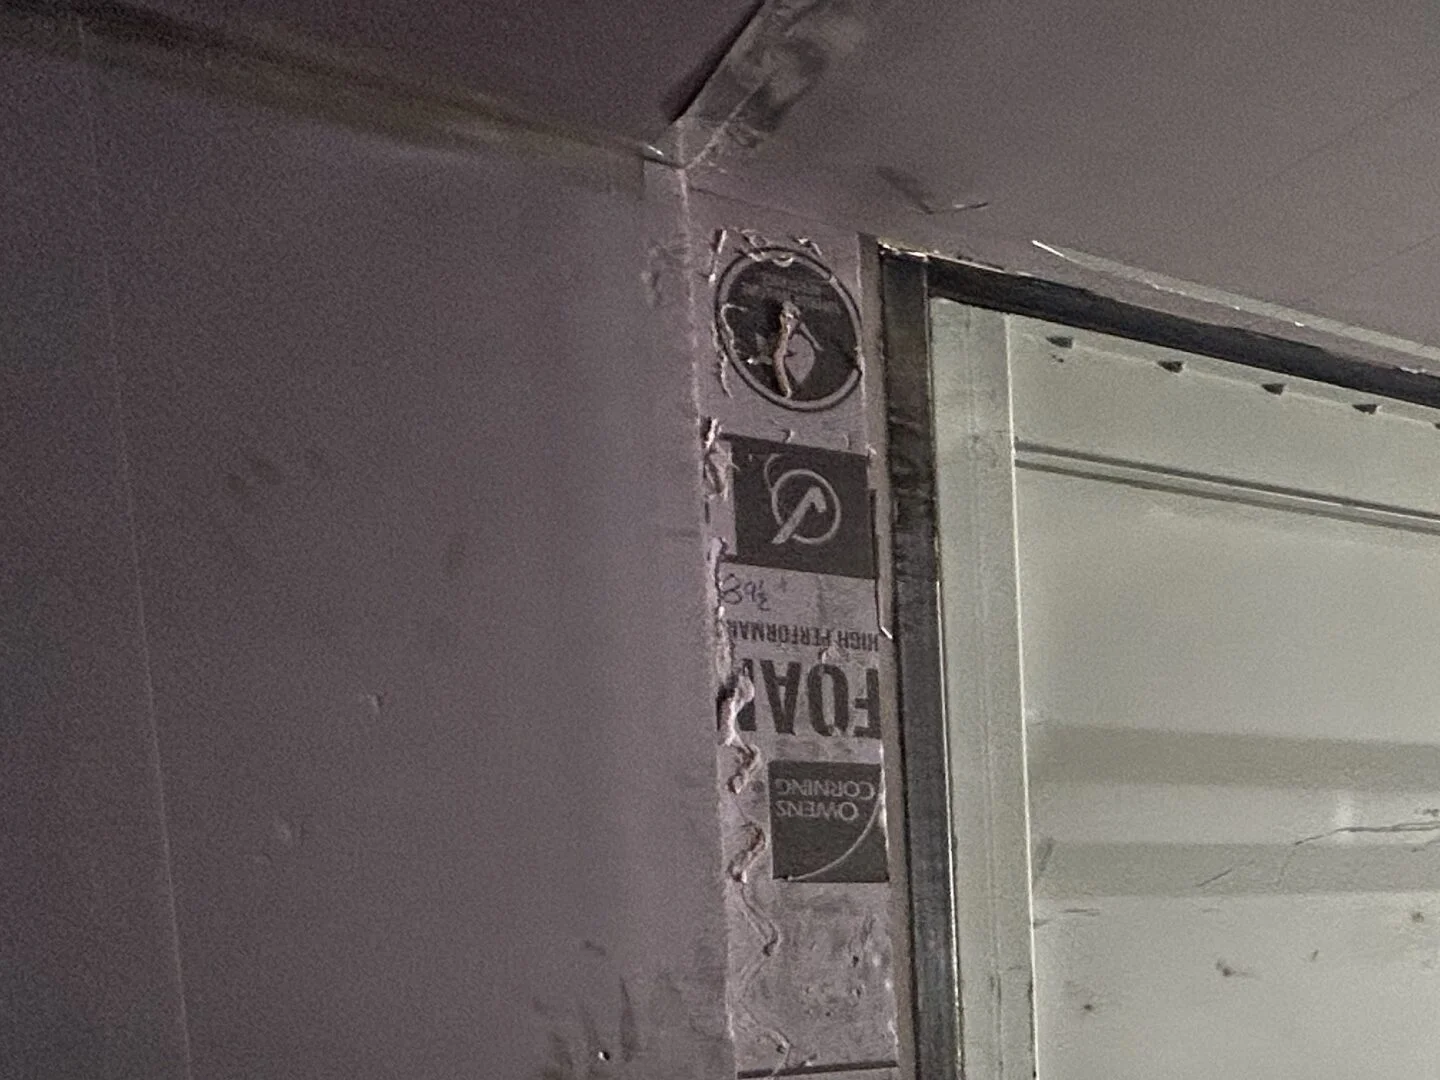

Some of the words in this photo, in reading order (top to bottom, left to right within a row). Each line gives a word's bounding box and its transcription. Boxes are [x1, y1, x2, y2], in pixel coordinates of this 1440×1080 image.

[837, 631, 880, 652] HIGH
[775, 778, 876, 801] CORNING
[775, 801, 860, 823] OWENS
